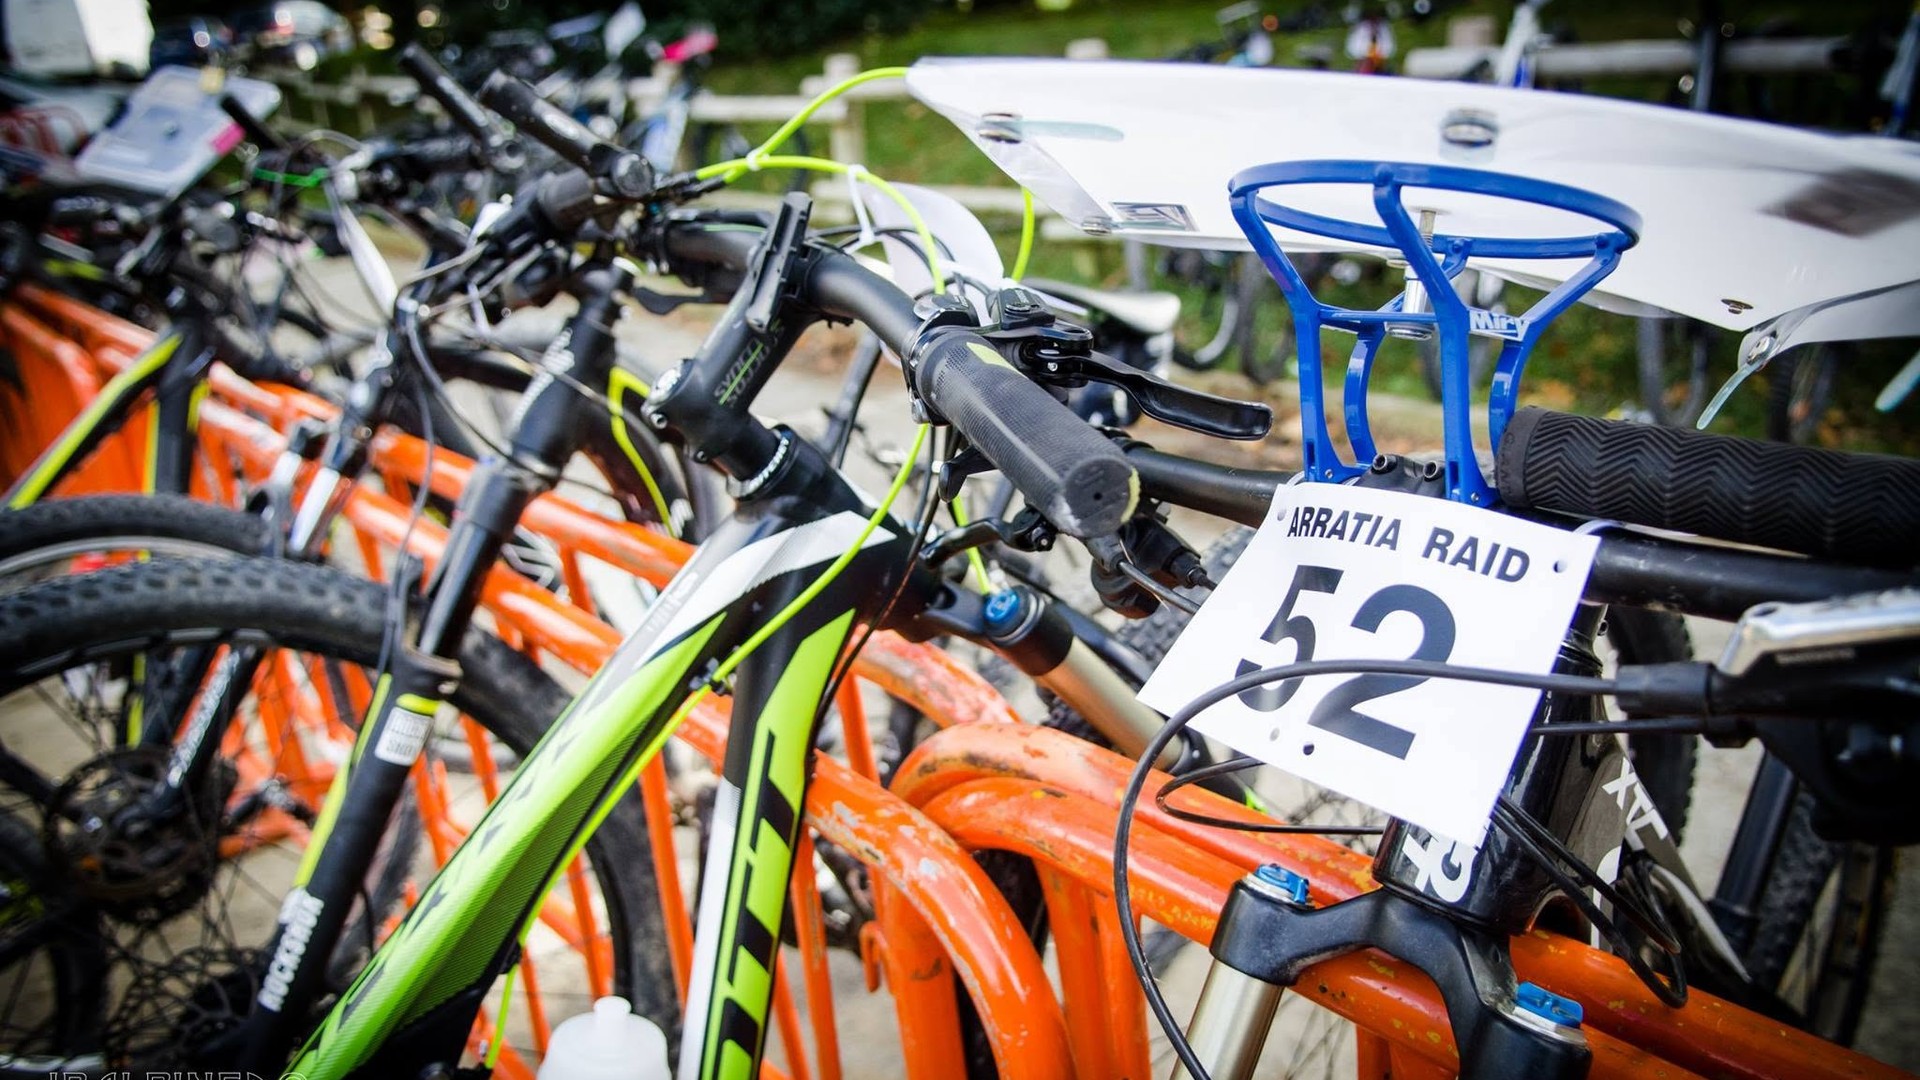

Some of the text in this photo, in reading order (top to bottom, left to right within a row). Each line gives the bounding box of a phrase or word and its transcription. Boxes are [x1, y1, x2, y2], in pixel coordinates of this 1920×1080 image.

[1469, 309, 1530, 341] Miry
[1287, 506, 1531, 583] ARRATIA RAID
[1234, 564, 1456, 760] 52
